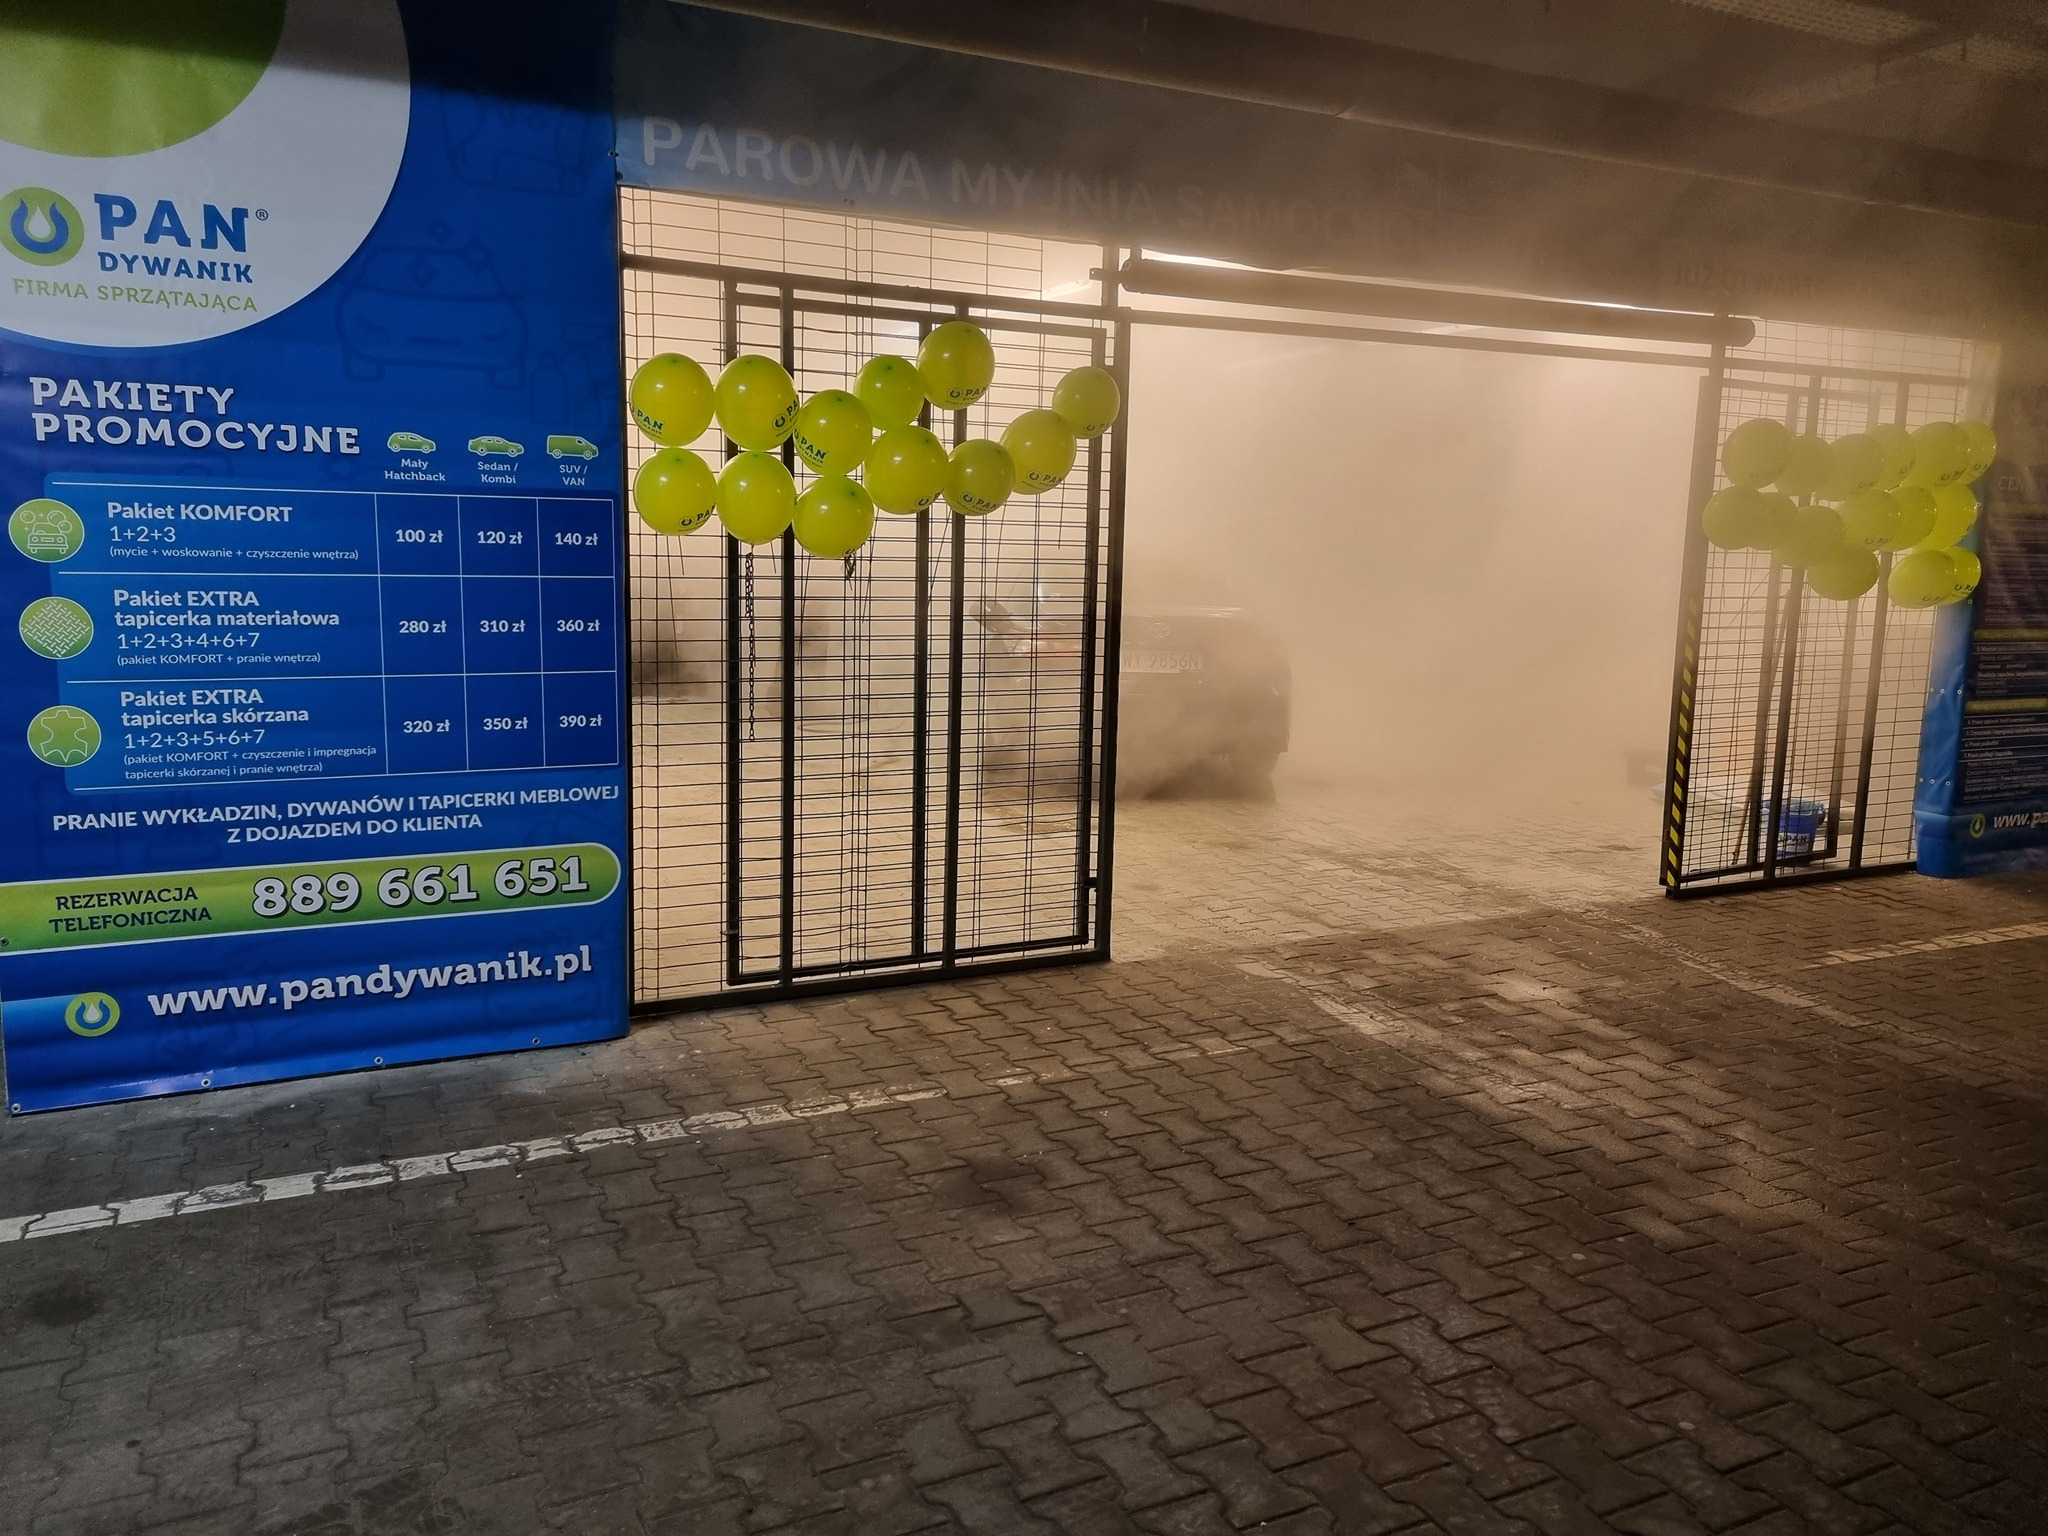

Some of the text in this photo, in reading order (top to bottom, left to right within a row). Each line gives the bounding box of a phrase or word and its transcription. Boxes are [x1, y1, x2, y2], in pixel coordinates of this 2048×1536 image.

[642, 116, 930, 210] PAROWA
[951, 158, 1158, 225] MYJNIA
[98, 251, 253, 284] DYWANIK
[12, 278, 257, 313] FIRMA SPRZĄTAJĄCA
[30, 376, 234, 414] PAKIETY
[636, 408, 664, 431] PAN
[32, 413, 361, 455] PROMOCYJNE
[801, 436, 827, 460] PAN
[401, 458, 428, 470] Mały
[477, 462, 511, 472] Sedan
[559, 465, 582, 474] SUV
[384, 471, 446, 482] Hatchback
[481, 475, 517, 484] Kombi
[562, 477, 585, 486] VAN
[107, 501, 293, 523] Pakiet KOMFORT
[110, 526, 177, 543] 1+2+3
[396, 529, 444, 543] 100 zł
[477, 531, 523, 545] 120 zł
[555, 532, 599, 546] 140 zł
[110, 545, 148, 558] (mycie
[161, 547, 233, 558] woskowanie
[246, 549, 310, 559] czyszczenie
[312, 548, 359, 561] wnętrza)
[114, 589, 260, 607] Pakiet EXTRA
[114, 610, 340, 630] tapicerka materiałowa
[399, 620, 447, 633] 280 zł
[480, 620, 526, 633] 310 zł
[557, 619, 600, 632] 360 zł
[118, 632, 260, 649] 1+2+3+4+6+7
[117, 654, 157, 666] (pakiet
[160, 653, 224, 665] KOMFORT
[236, 653, 271, 665] pranie
[273, 652, 321, 665] wnętrza)
[1149, 653, 1199, 669] 9856N
[120, 688, 264, 707] Pakiet EXTRA
[121, 707, 309, 729] tapicerka skórzana
[403, 720, 450, 733] 320 zł
[483, 717, 528, 731] 350 zł
[559, 714, 602, 728] 390 zł
[124, 729, 266, 749] 1+2+3+5+6+7
[123, 753, 163, 765] (pakiet
[166, 751, 229, 763] KOMFORT
[241, 748, 305, 761] czyszczenie
[313, 746, 377, 760] impregnacja
[125, 768, 175, 781] tapicerki
[177, 765, 231, 778] skórzanej
[239, 764, 274, 776] pranie
[276, 762, 323, 775] wnętrza)
[52, 809, 138, 831] PRANIE
[142, 803, 283, 828] WYKŁADZIN,
[287, 793, 405, 820] DYWANÓW
[419, 790, 515, 811] TAPICERKI
[520, 785, 619, 806] MEBLOWEJ
[227, 813, 483, 844] Z DOJAZDEM DO KLIENTA
[251, 855, 589, 917] 889 661 651
[55, 886, 198, 910] REZERWACJA
[48, 907, 212, 934] TELEFONICZNA
[148, 945, 593, 1016] www.pandywanik.pl
